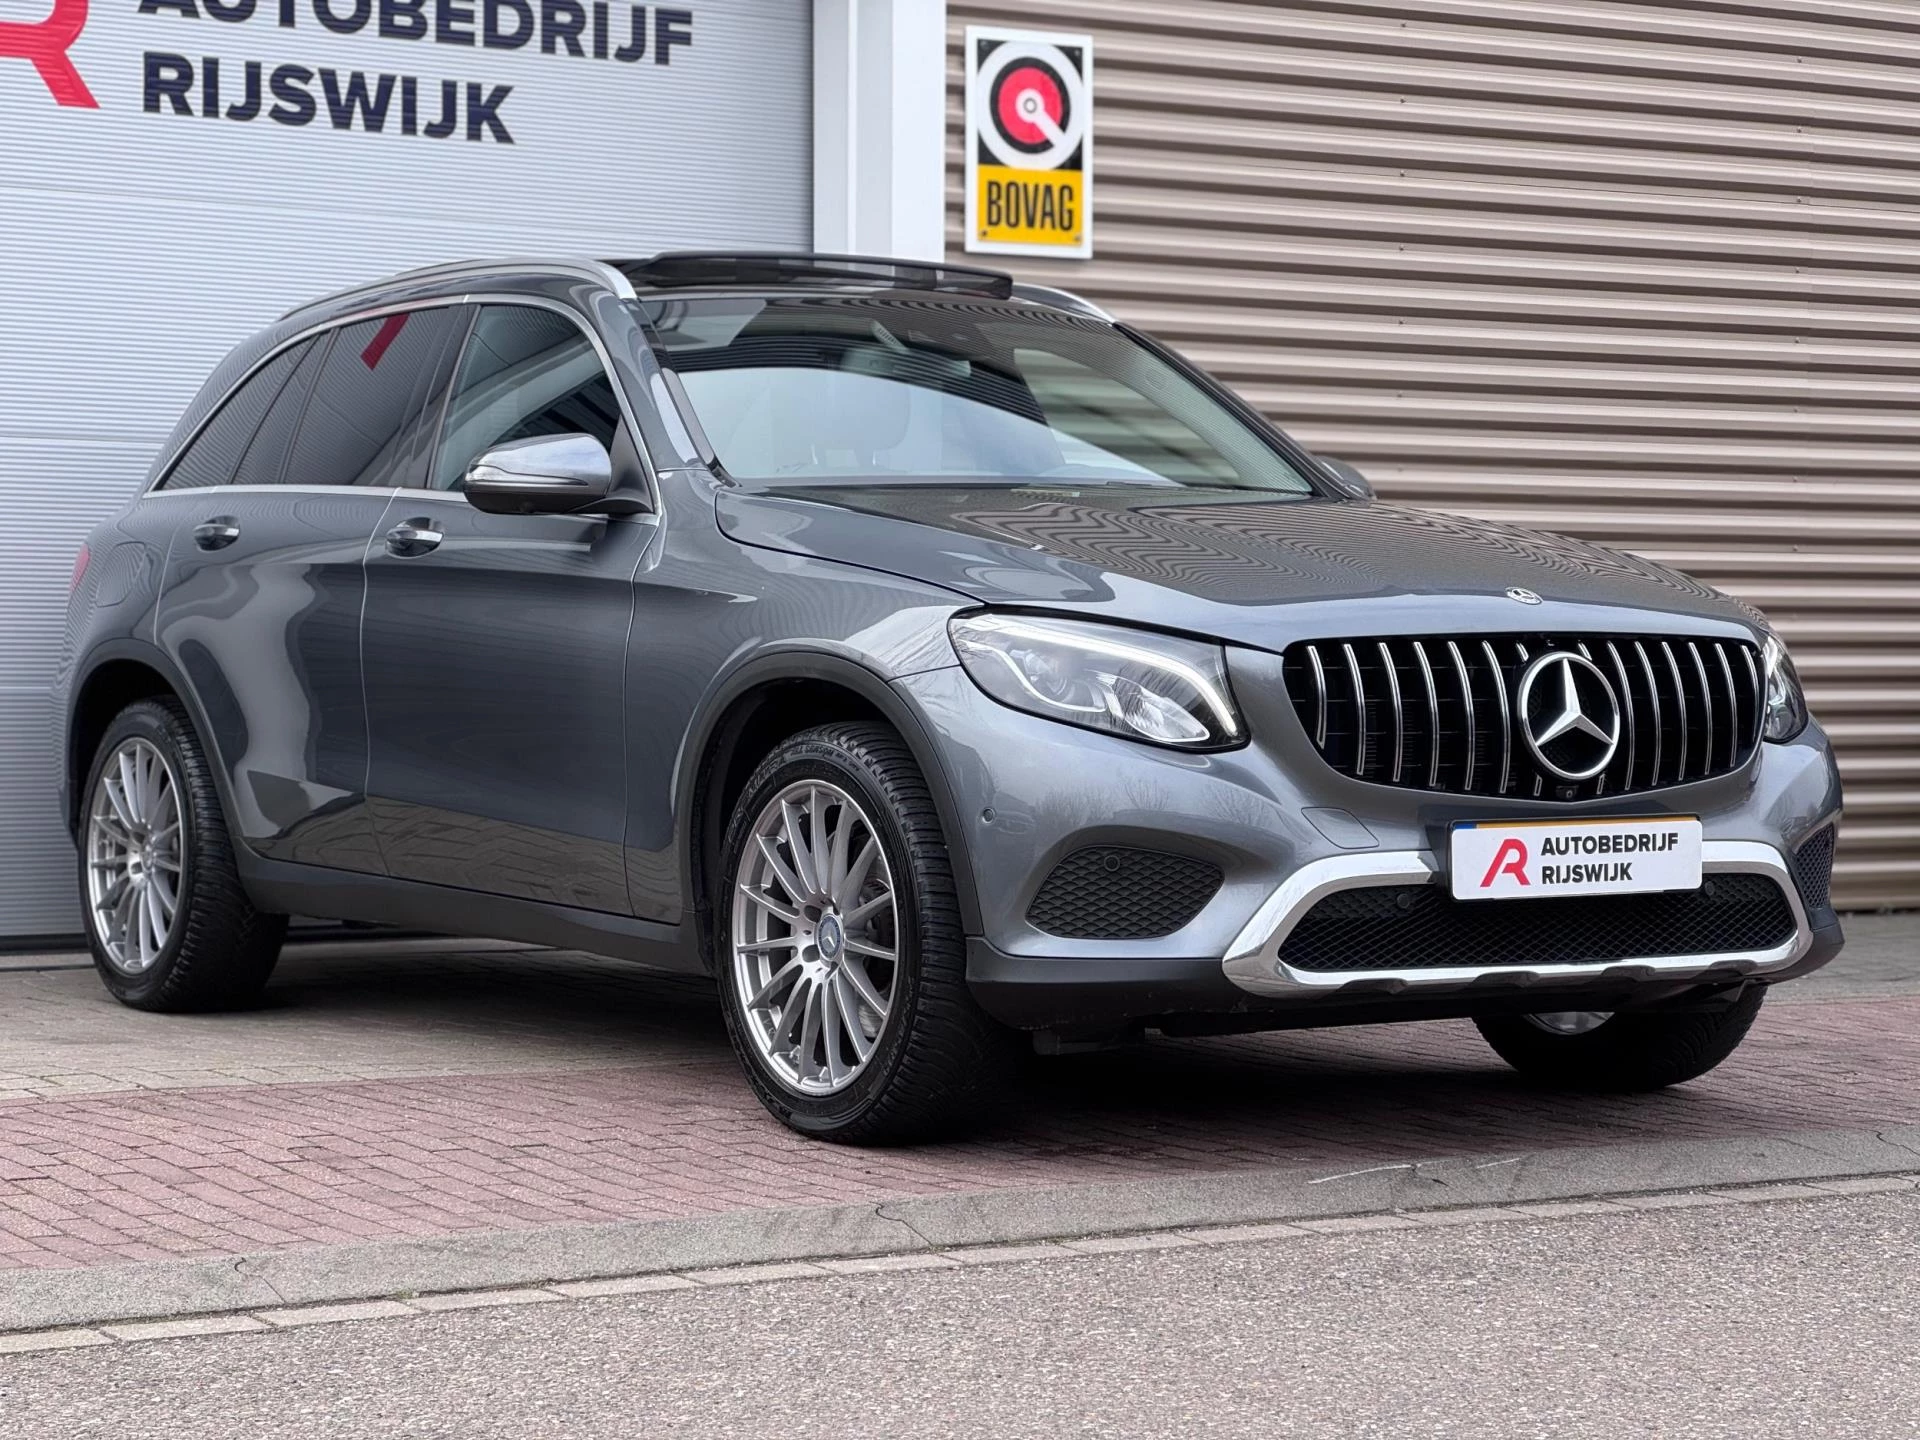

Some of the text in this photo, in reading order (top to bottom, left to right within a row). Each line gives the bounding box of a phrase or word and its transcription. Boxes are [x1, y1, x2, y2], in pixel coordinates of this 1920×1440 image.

[137, 0, 693, 66] OBEDRIJF
[143, 51, 514, 145] RIJSWIJK
[987, 181, 1073, 231] BOVAG
[1540, 832, 1679, 856] AUTOBEDRIJF
[1541, 862, 1633, 885] RIJSWIJK
